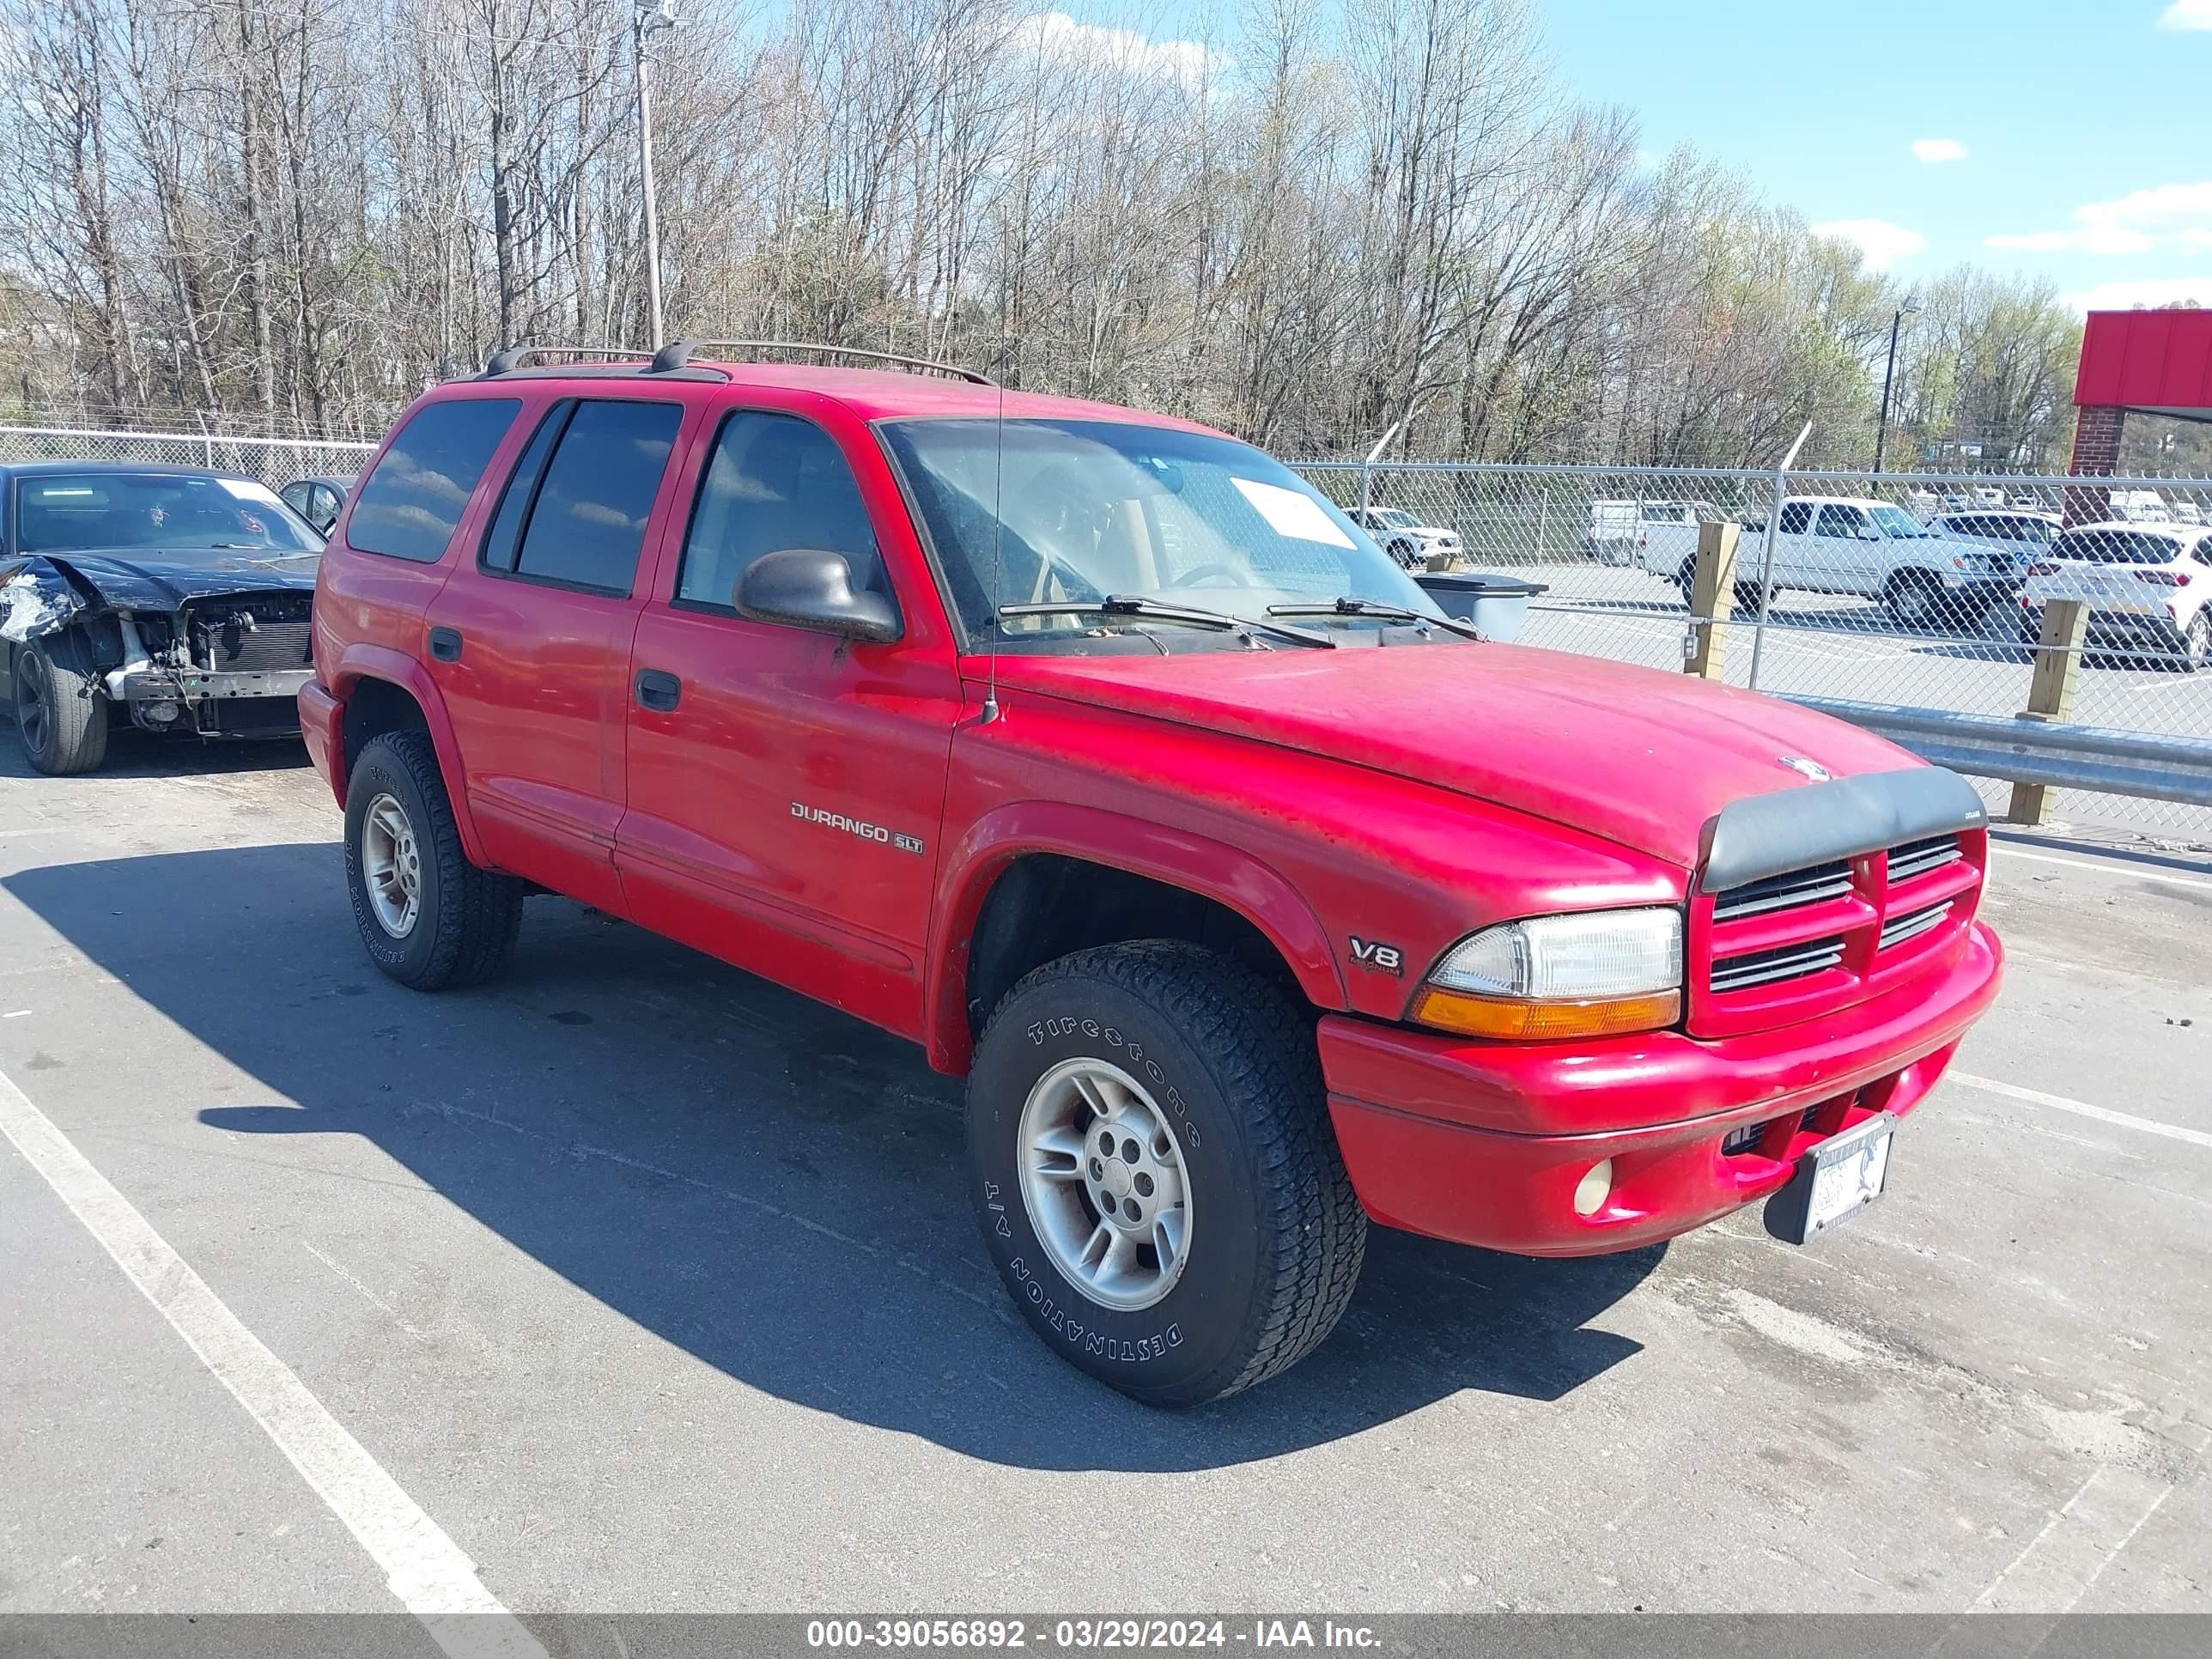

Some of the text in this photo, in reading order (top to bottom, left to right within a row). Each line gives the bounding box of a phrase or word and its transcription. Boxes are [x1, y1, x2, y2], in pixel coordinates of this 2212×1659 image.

[791, 802, 922, 853] DURANGO SLT
[1350, 938, 1400, 969] V8
[985, 1182, 1012, 1237] A/T
[1011, 1257, 1184, 1361] DESTINATION
